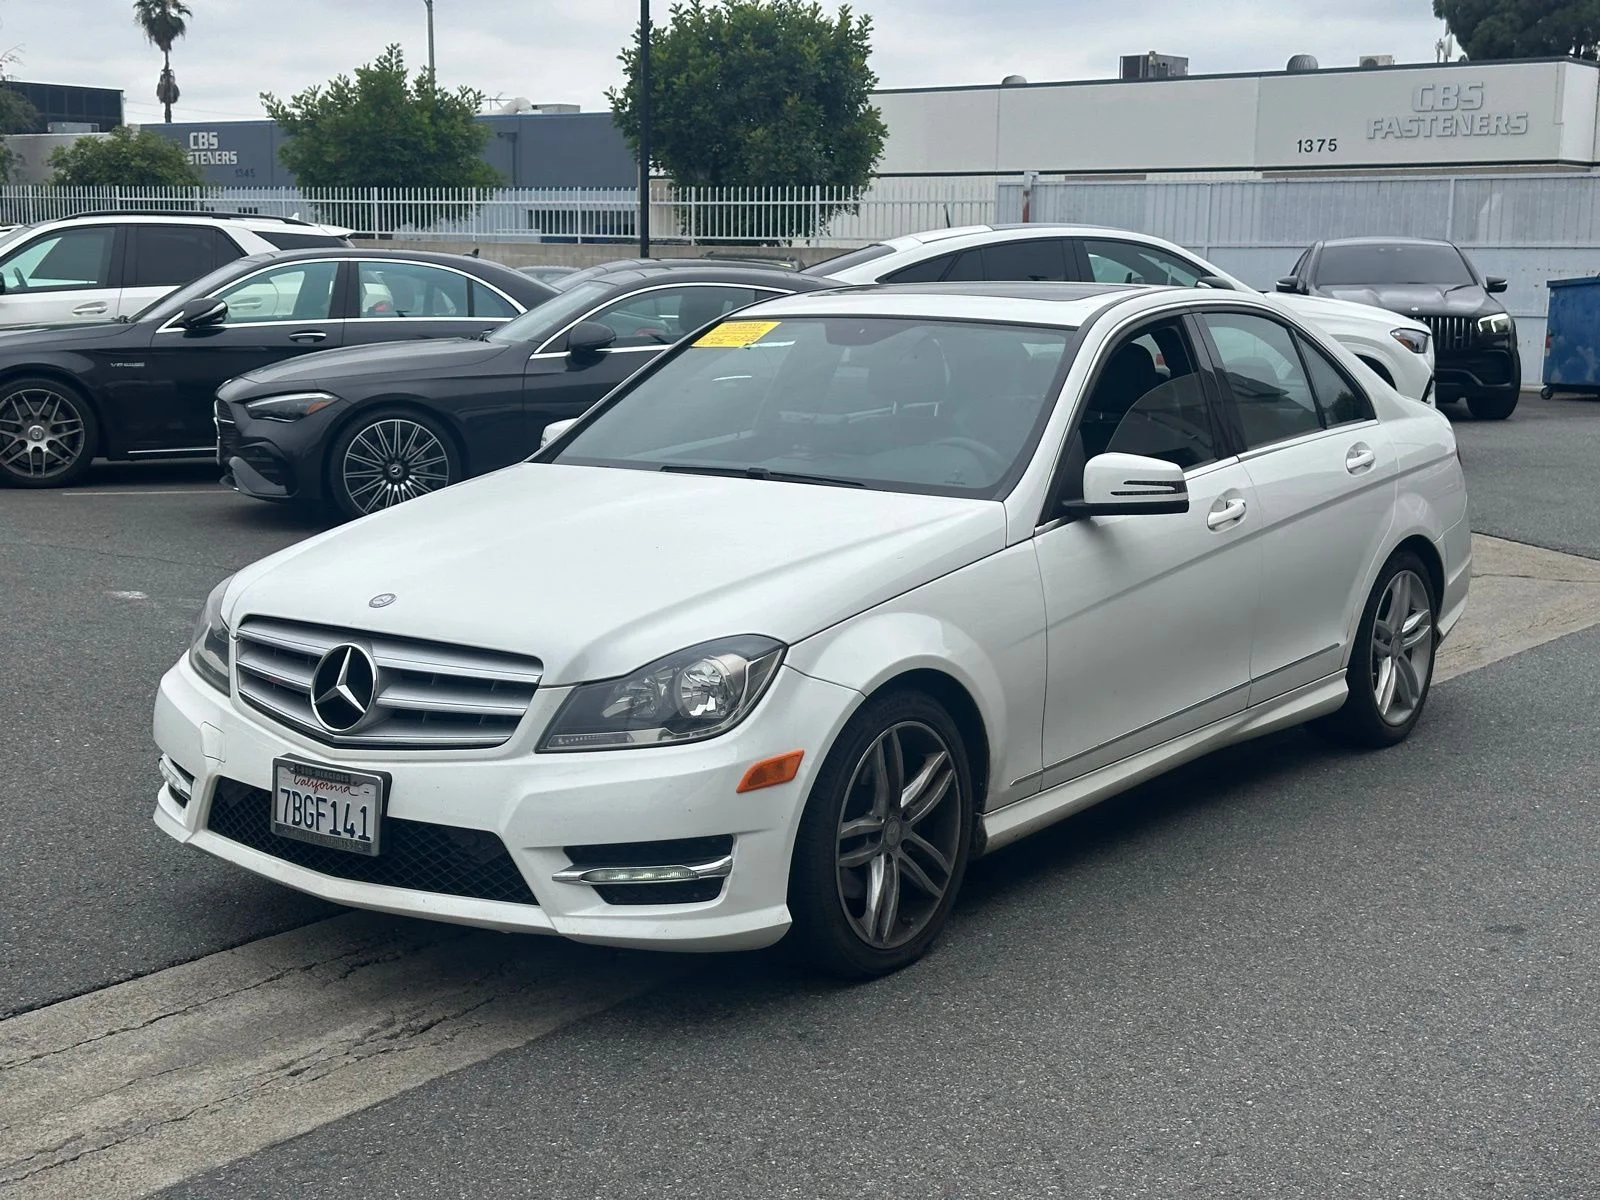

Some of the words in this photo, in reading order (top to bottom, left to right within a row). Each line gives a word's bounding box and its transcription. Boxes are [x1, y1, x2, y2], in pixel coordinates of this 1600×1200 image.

[1412, 82, 1484, 113] CBS
[1367, 112, 1529, 140] FASTENERS
[189, 131, 219, 150] CBS
[1297, 138, 1338, 153] 1375
[187, 151, 238, 165] STENERS
[293, 774, 359, 797] California
[280, 787, 371, 842] 7BGF141
